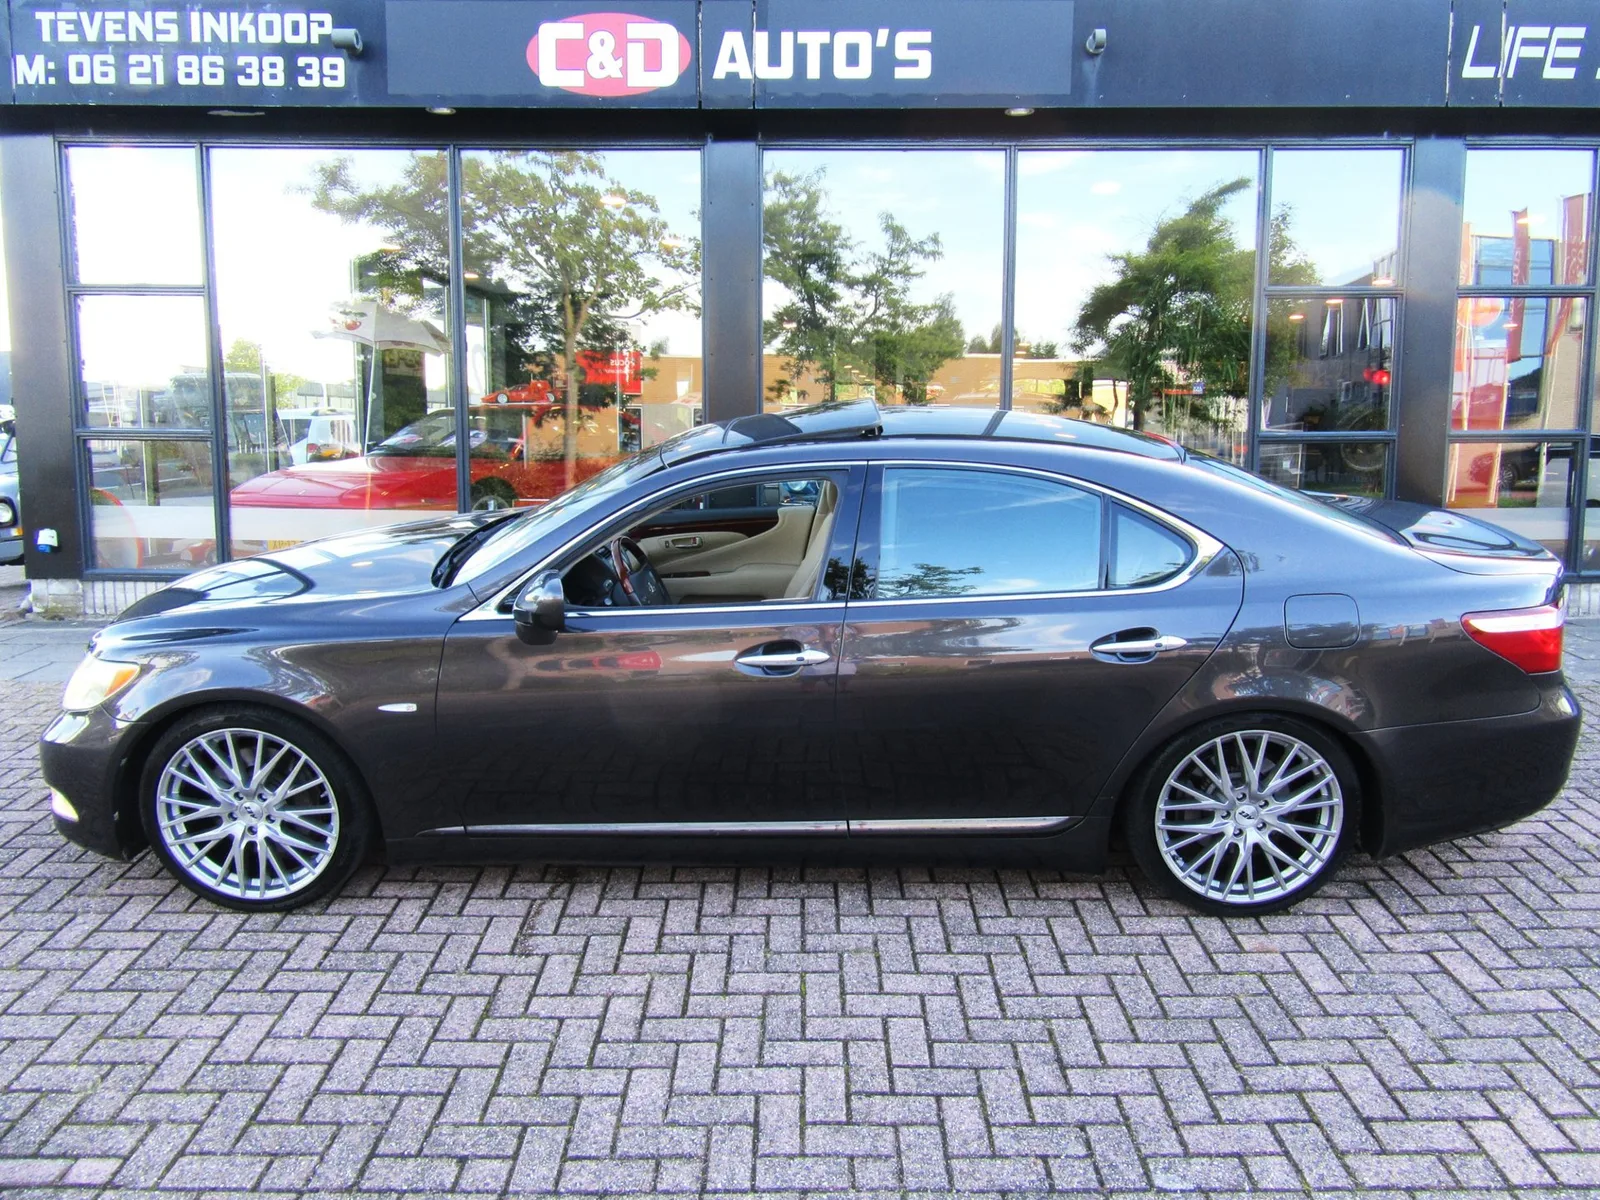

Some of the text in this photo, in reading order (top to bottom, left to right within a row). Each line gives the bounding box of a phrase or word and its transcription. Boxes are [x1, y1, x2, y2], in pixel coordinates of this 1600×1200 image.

[35, 11, 332, 44] TEVENS INKOOP
[15, 54, 346, 88] M: 06 21 86 38 39
[538, 22, 932, 87] C&D AUTO'S
[1461, 25, 1587, 79] LIFE
